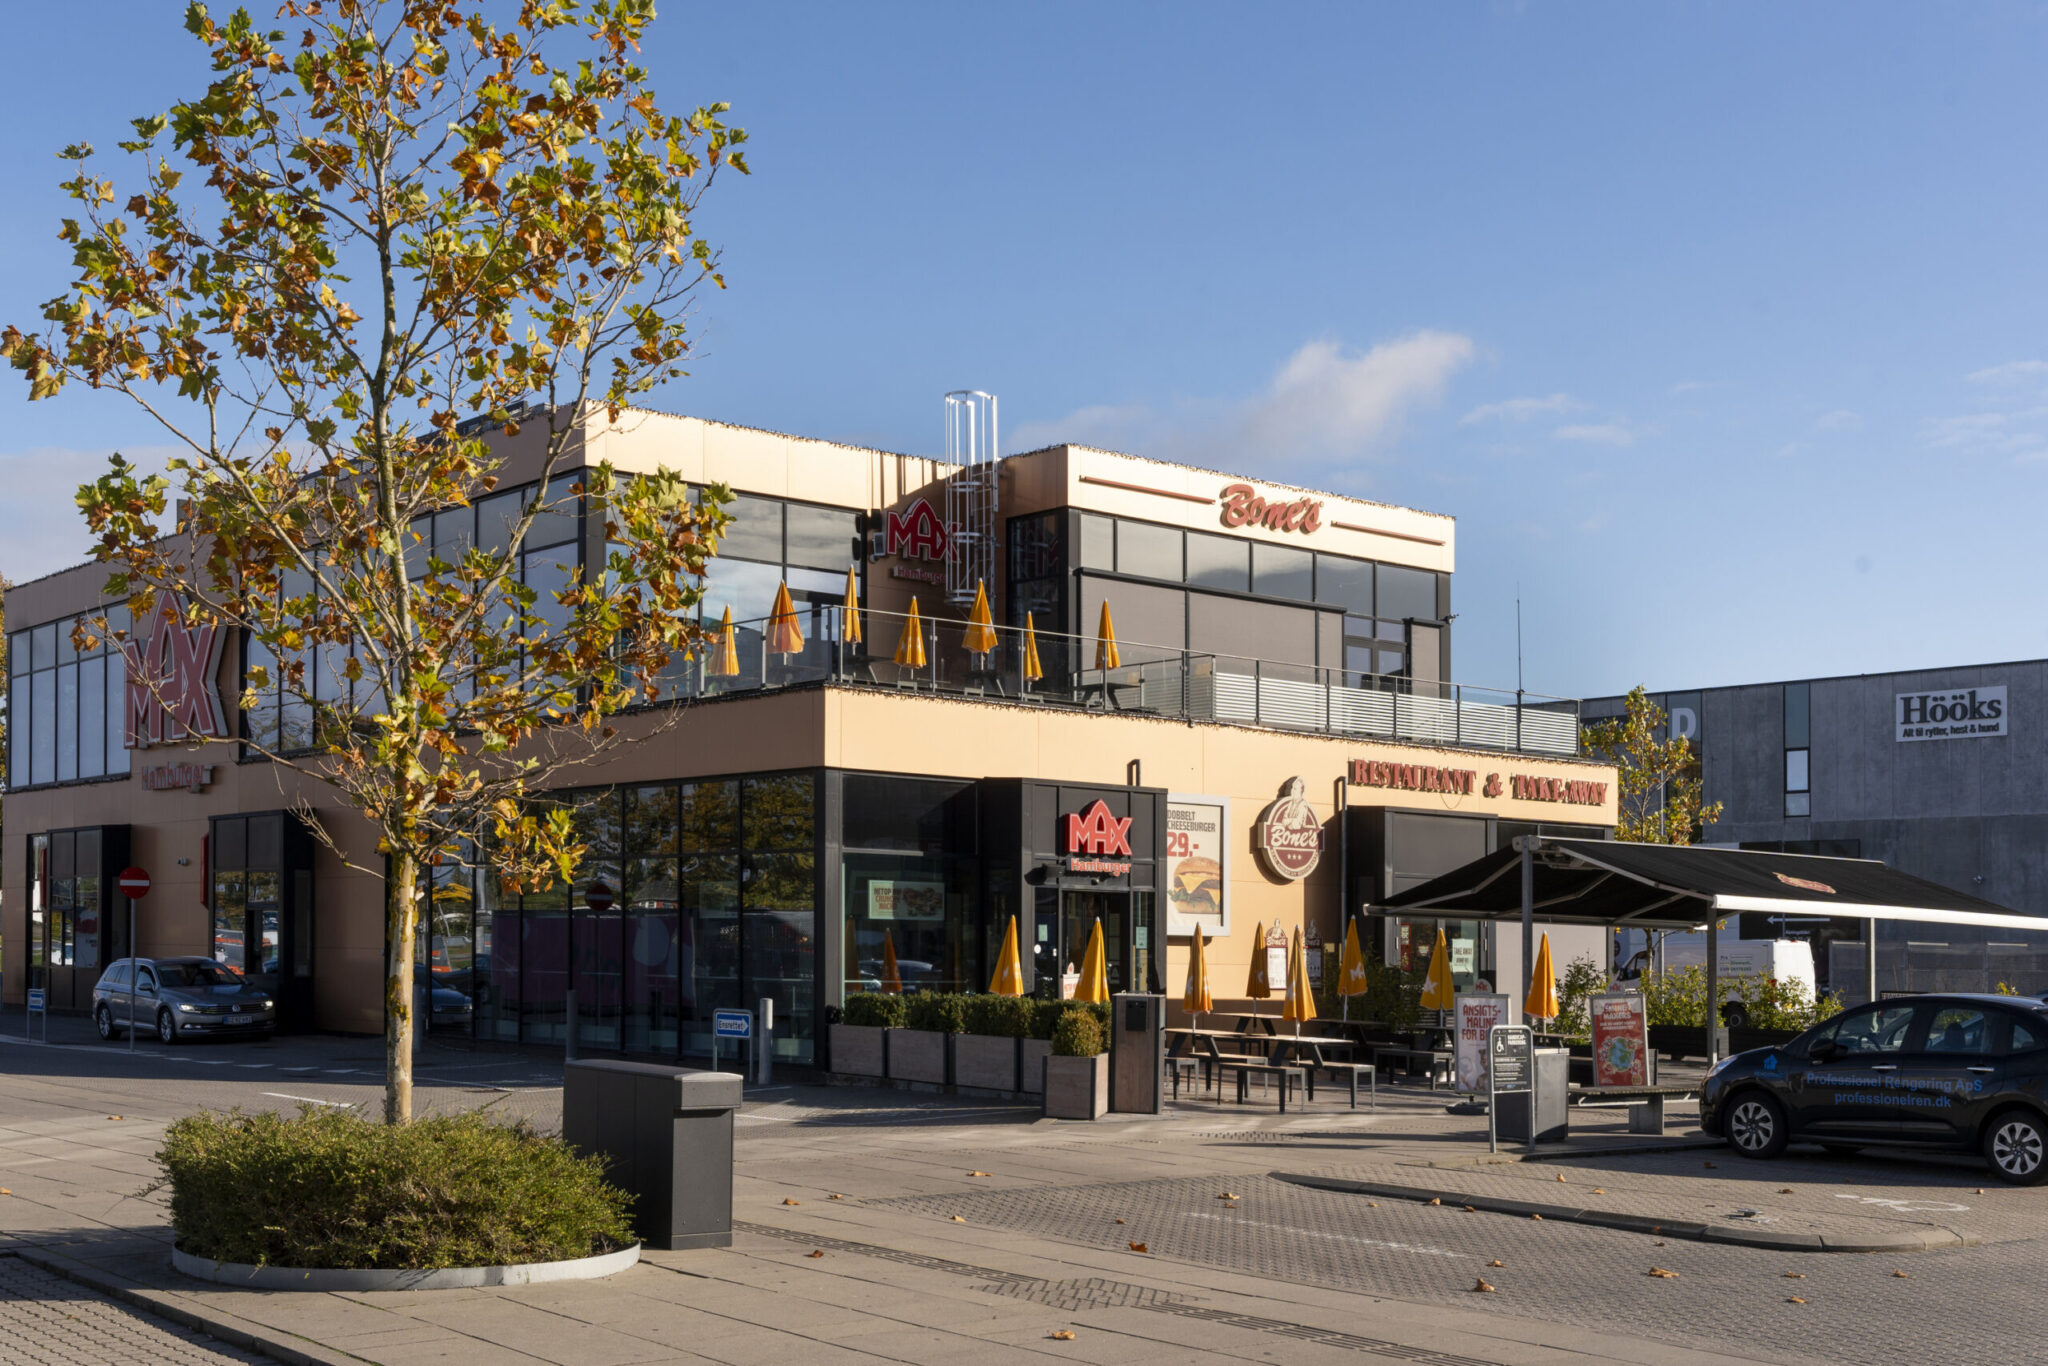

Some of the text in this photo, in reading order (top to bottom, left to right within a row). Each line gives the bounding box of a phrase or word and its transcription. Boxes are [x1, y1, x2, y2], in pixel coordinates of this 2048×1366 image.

[1221, 484, 1322, 533] Bone's
[887, 497, 961, 564] MAX
[897, 565, 951, 587] Hamburge
[124, 587, 219, 748] MAX
[1900, 689, 2002, 725] Hööks
[1671, 707, 1697, 742] D
[1902, 728, 1914, 738] Alt
[1969, 724, 1977, 733] &
[1978, 722, 1999, 733] hund
[1353, 758, 1477, 794] RESTAURANT
[1488, 772, 1503, 797] &
[1069, 799, 1133, 856] MAX
[1270, 824, 1319, 848] Bone's
[1167, 831, 1200, 858] 29,-
[1070, 857, 1132, 877] Hamburger
[1463, 1004, 1502, 1018] ANSIGTS-
[1461, 1029, 1478, 1041] FOR
[1806, 1072, 1984, 1093] Professionel Rengøring ApS
[1834, 1091, 1952, 1109] professionelren.dk
